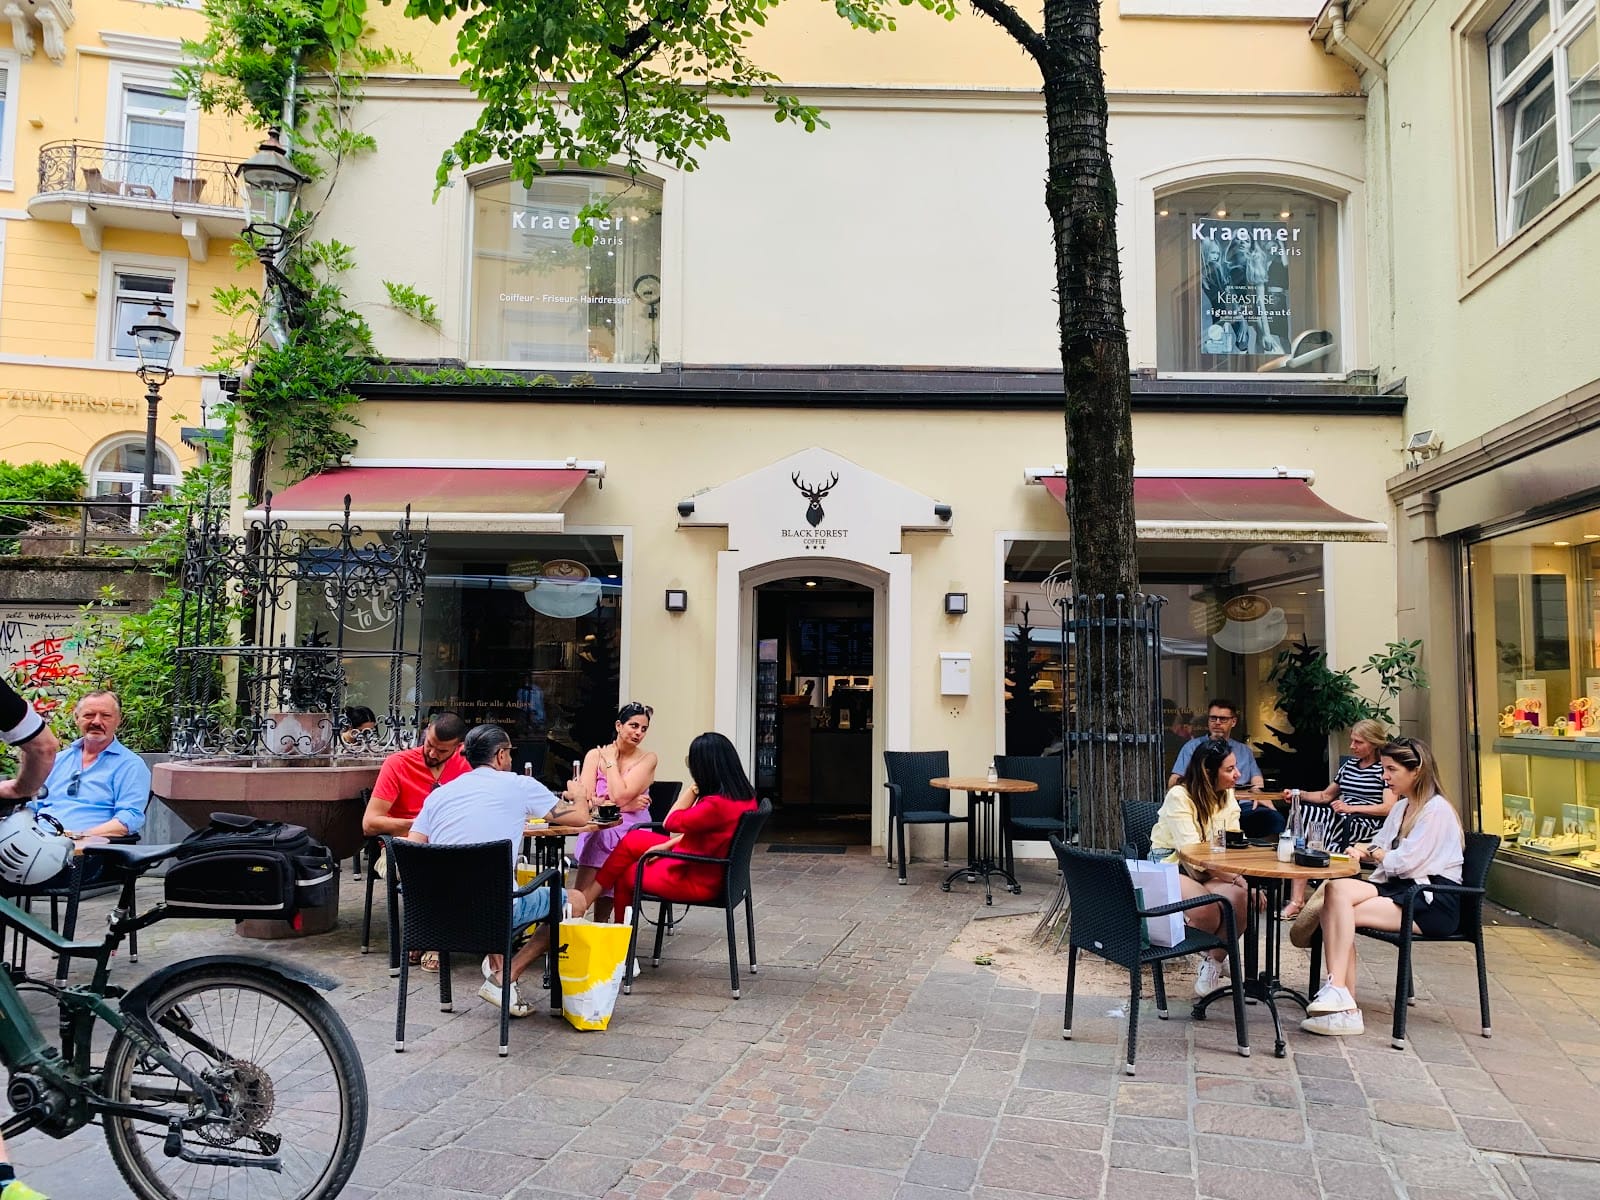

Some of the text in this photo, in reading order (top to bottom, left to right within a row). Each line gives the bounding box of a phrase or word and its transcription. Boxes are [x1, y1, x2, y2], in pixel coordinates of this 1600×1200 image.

[1191, 222, 1301, 241] Kraemer
[592, 236, 624, 246] Paris
[1271, 246, 1302, 256] Paris
[499, 293, 534, 303] Coiffeur
[580, 295, 632, 305] Hairdresser
[7, 390, 140, 416] ZUM HIRSCH
[781, 529, 848, 538] BLACK FOREST
